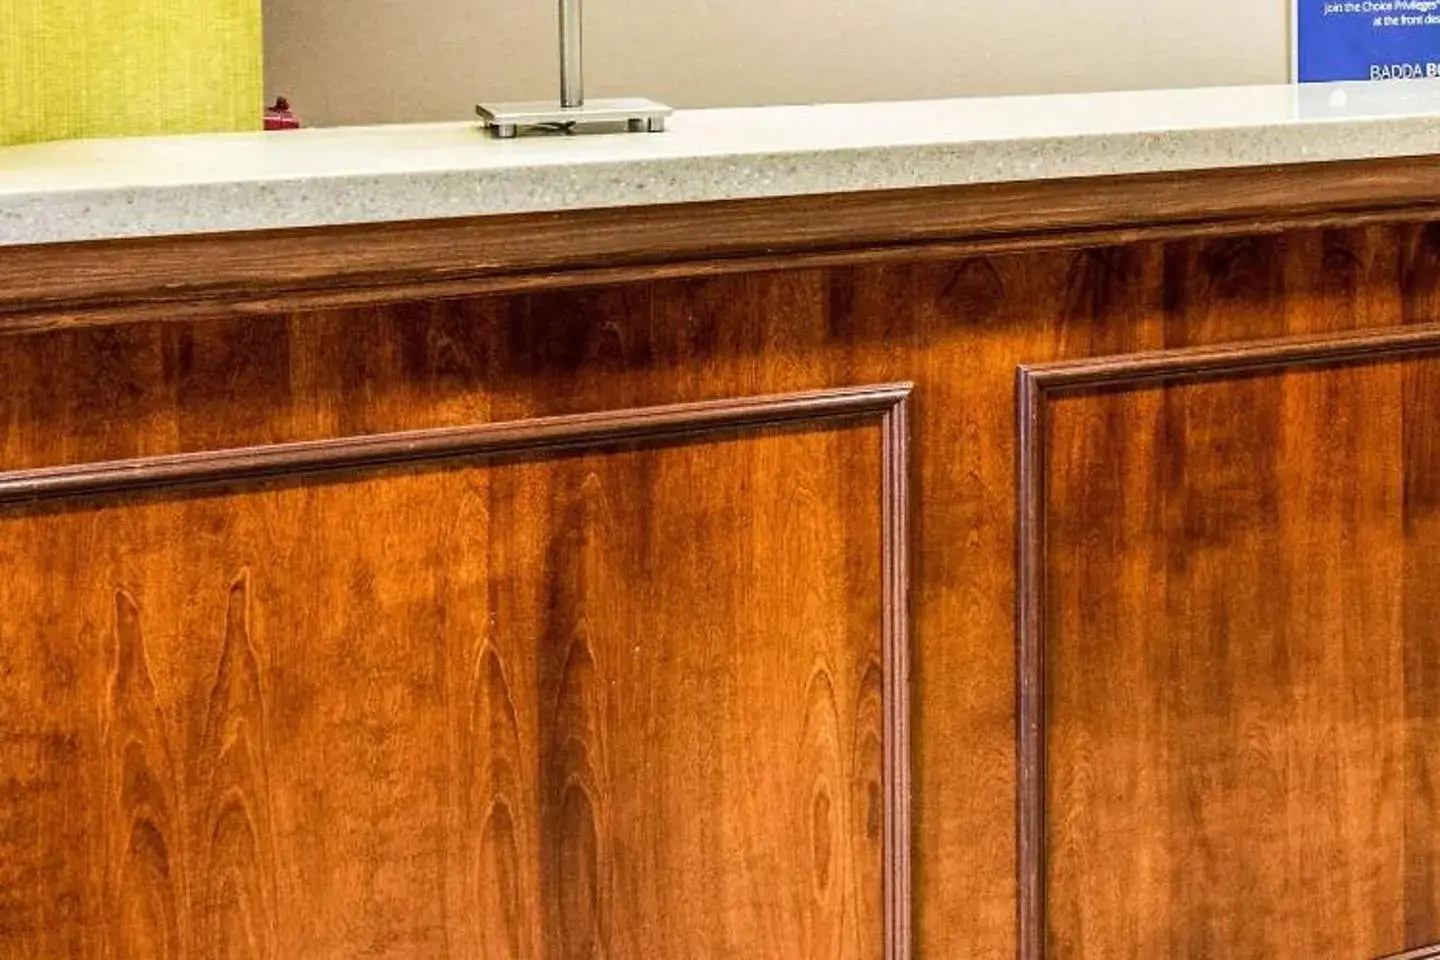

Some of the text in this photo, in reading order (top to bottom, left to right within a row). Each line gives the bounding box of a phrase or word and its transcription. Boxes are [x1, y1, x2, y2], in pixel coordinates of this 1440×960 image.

[1344, 2, 1361, 12] the
[1362, 1, 1392, 12] Choice
[1373, 17, 1382, 26] at
[1384, 16, 1398, 26] the
[1401, 14, 1424, 26] front
[1370, 63, 1423, 80] BADDA
